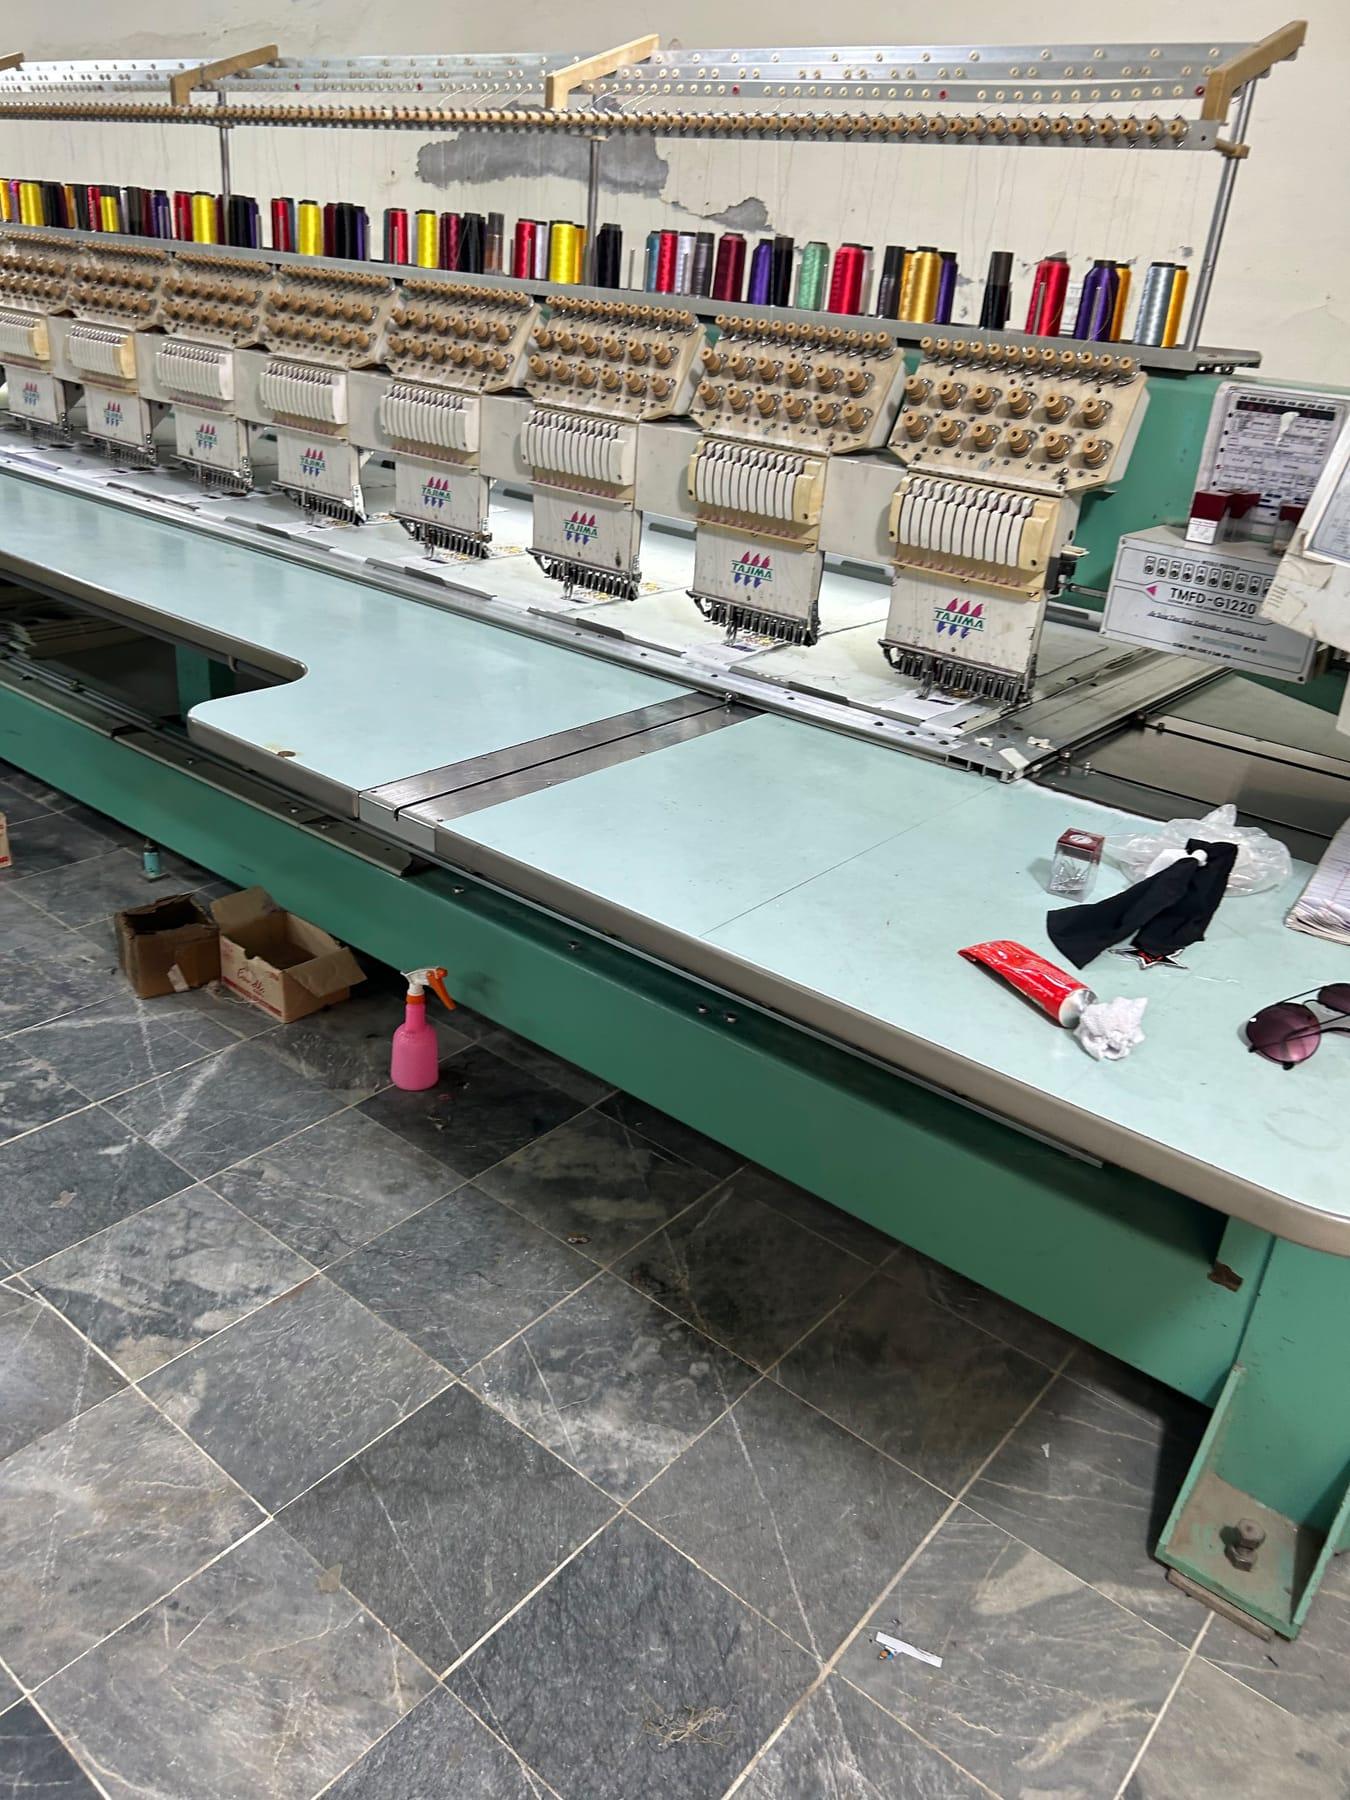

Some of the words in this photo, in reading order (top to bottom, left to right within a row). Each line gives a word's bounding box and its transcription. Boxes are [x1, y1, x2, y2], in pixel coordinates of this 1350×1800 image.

[563, 521, 598, 536] TAJIMA
[731, 562, 772, 578] TAJIMA
[1170, 587, 1257, 615] TMFD-G1220
[934, 610, 984, 629] TAJIMA
